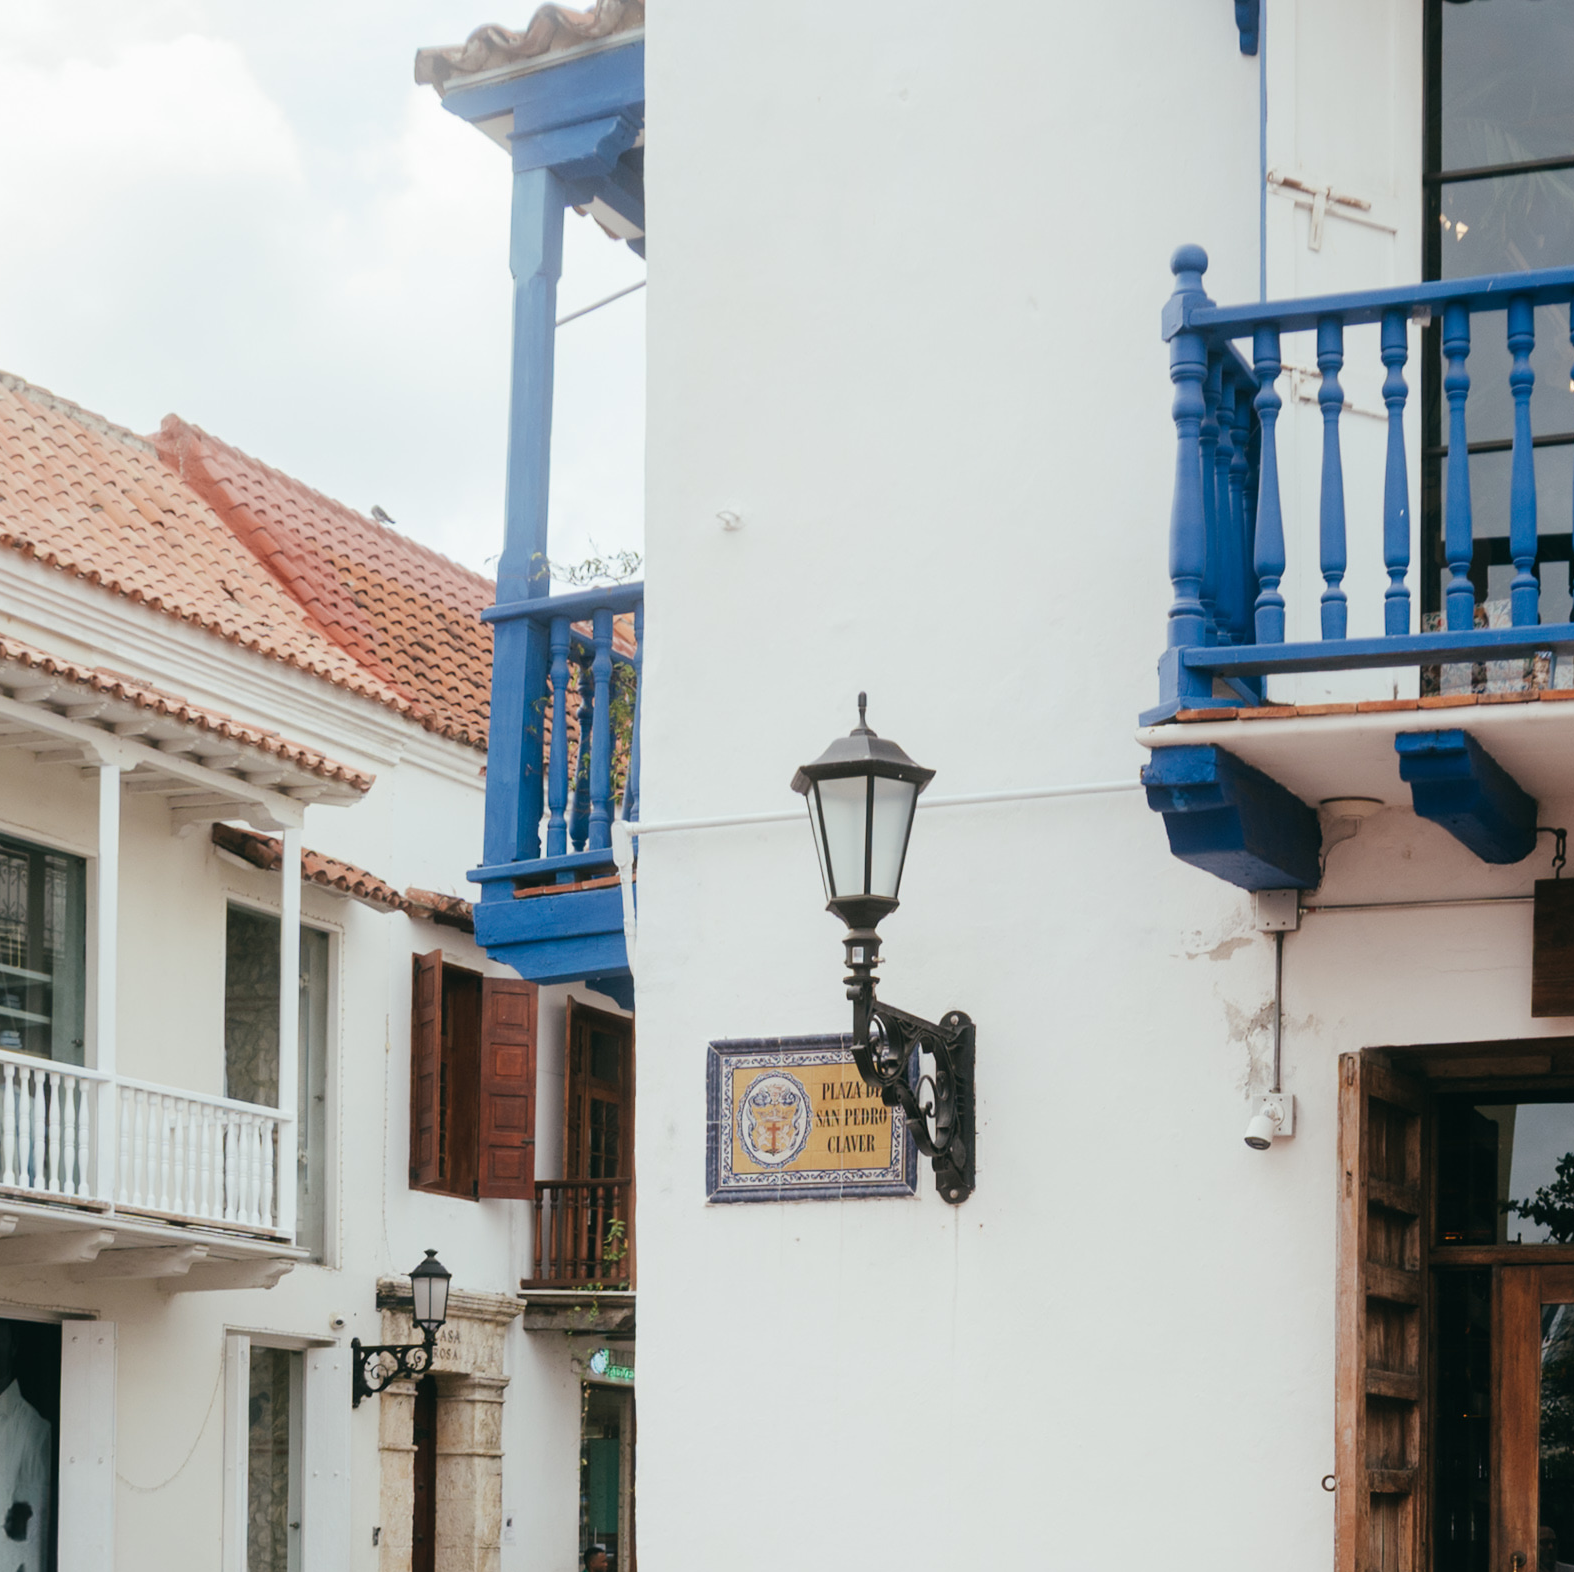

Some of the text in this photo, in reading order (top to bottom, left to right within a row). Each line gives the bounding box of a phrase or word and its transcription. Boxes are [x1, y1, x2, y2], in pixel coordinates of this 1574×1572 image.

[822, 1081, 863, 1100] PLAZA
[816, 1107, 888, 1128] SAN PEDRO
[827, 1134, 875, 1154] CLAVER
[439, 1329, 461, 1344] ASA
[433, 1347, 458, 1360] ROSA
